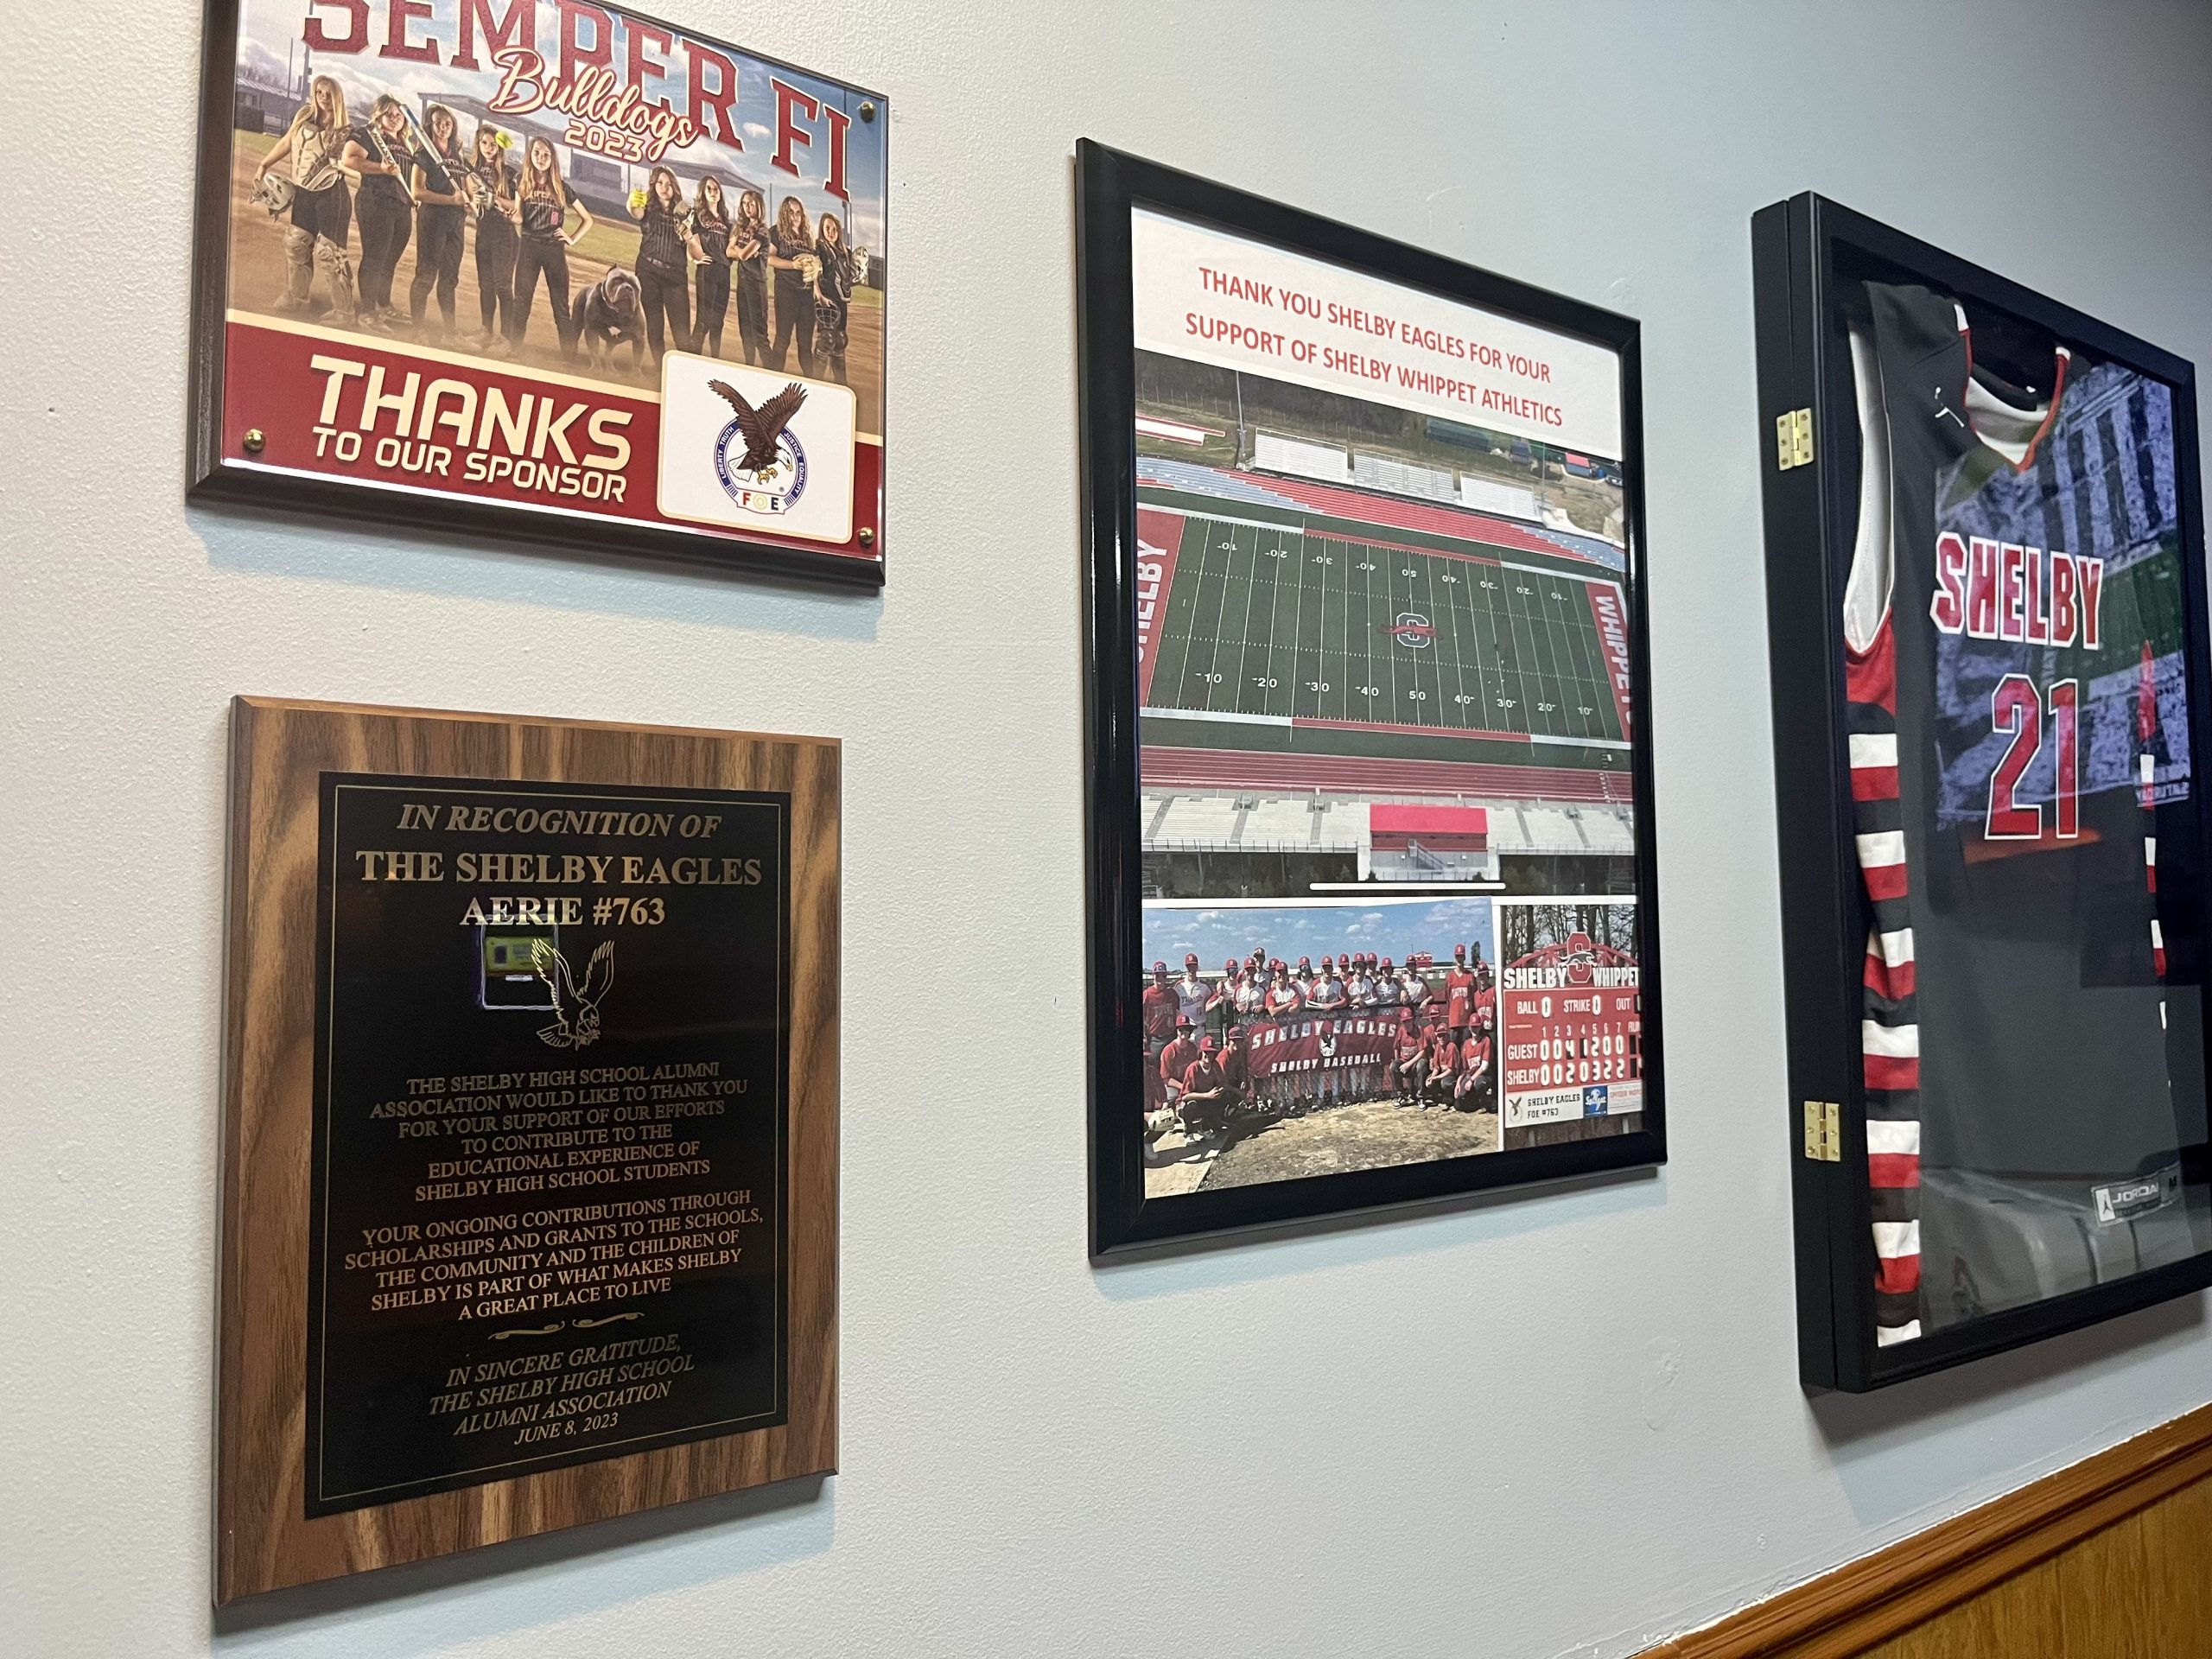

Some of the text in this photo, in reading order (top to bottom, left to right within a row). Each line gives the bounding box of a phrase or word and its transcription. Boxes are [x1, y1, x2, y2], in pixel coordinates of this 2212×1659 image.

[489, 45, 699, 162] Bulldogs
[563, 119, 645, 163] 2023
[769, 75, 852, 203] FI
[1199, 267, 1550, 382] THANK YOU SHELBY EAGLES FOR YOUR
[1185, 312, 1564, 429] SUPPORT OF SHELBY WHIPPET ATHLETICS
[310, 354, 634, 473] THANKS
[312, 426, 629, 504] TO OUR SPONSOR
[716, 426, 735, 480] LIBERTY TRUTH
[784, 432, 805, 494] JUSTICE EQUALITY
[1929, 530, 2103, 651] SHELBY
[1986, 673, 2079, 841] 21
[397, 804, 721, 837] IN RECOGNITION OF
[356, 851, 761, 885] THE SHELBY EAGLES
[459, 897, 664, 927] AERIE #763
[1503, 968, 1567, 989] SHELBY
[1516, 1001, 1538, 1014] BALL
[1541, 996, 1551, 1018] 0
[1563, 999, 1591, 1014] STRIKE
[1592, 995, 1601, 1015] 0
[1616, 998, 1630, 1011] OUT
[1251, 1020, 1397, 1050] SHELBY EAGLES
[1507, 1044, 1538, 1060] GUEST
[407, 1062, 719, 1094] THE SHELBY HIGH SCHOOL ALUMNI
[1270, 1053, 1382, 1073] SHELBY BASEBALL
[1507, 1068, 1540, 1086] SHELBY
[370, 1079, 747, 1118] ASSOCIATION WOULD LIKE TO THANK YOU
[399, 1100, 724, 1138] FOR YOUR SUPPORT OF OUR EFFORTS
[1527, 1110, 1540, 1119] FOE
[429, 1141, 700, 1179] EDUCATIONAL EXPERIENCE OF
[461, 1124, 672, 1154] TO CONTRIBUTE TO THE
[416, 1160, 709, 1201] SHELBY HIGH SCHOOL STUDENTS
[345, 1208, 763, 1269] SCHOLARSHIPS AND GRANTS TO THE SCHOOLS,
[362, 1190, 751, 1248] YOUR ONGOING CONTRIBUTIONS THROUGH
[372, 1249, 742, 1311] SHELBY IS PART OF WHAT MAKES SHELBY
[376, 1230, 740, 1287] THE COMMUNITY AND THE CHILDREN OF
[458, 1277, 671, 1320] A GREAT PLACE TO LIVE
[446, 1334, 680, 1387] IN SINCERE GRATITUDE,
[430, 1355, 694, 1414] THE SHELBY HIGH SCHOOL
[454, 1381, 672, 1435] ALUMNI ASSOCIATION
[514, 1412, 618, 1445] JUNE 8, 2023
